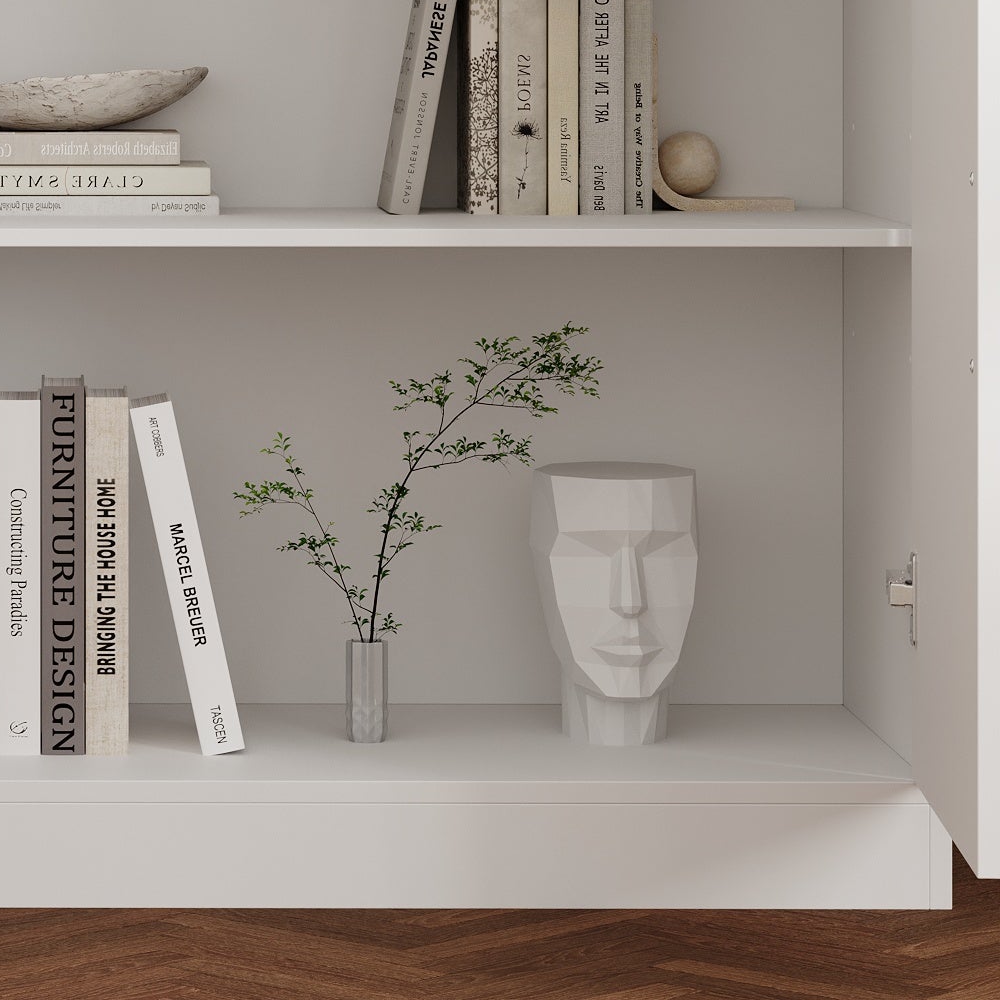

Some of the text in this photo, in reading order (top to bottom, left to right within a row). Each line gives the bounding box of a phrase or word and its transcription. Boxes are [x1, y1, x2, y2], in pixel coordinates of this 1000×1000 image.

[6, 488, 28, 637] Constructing Paradies
[51, 393, 76, 752] FURNITURE DESIGN
[97, 478, 116, 675] BRINGING THE HOUSE HOME
[169, 523, 207, 648] MARCEL BREUER
[209, 704, 227, 744] TASCEN
